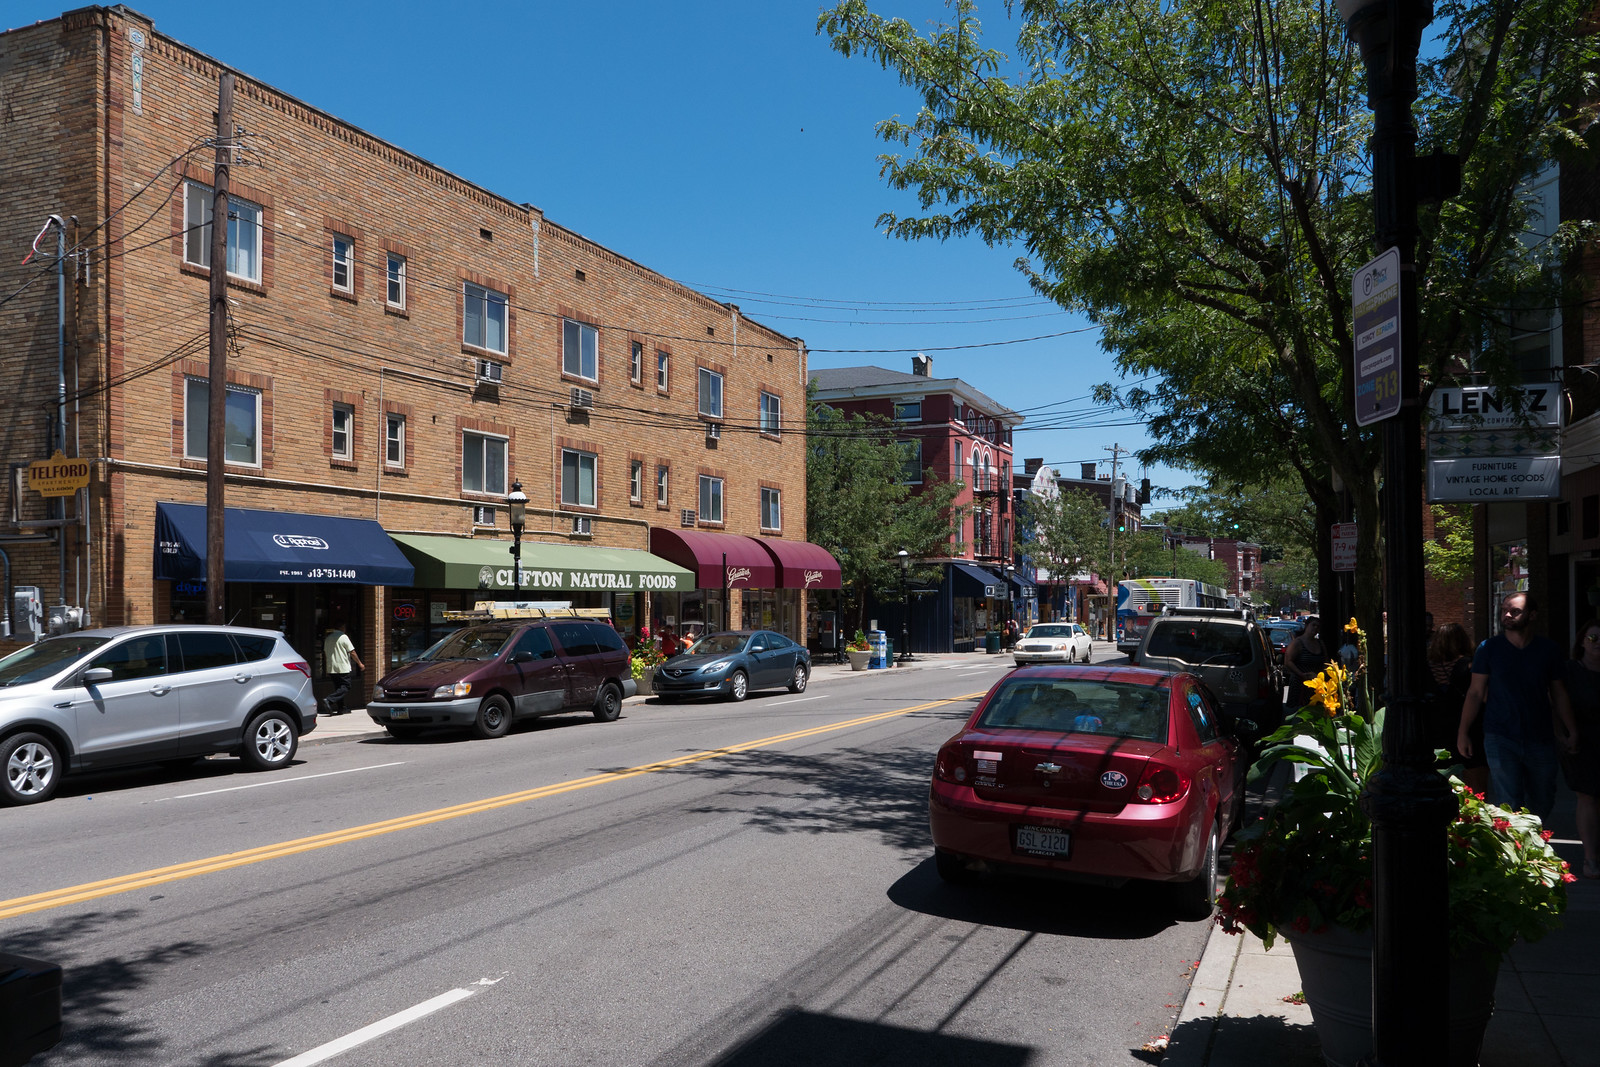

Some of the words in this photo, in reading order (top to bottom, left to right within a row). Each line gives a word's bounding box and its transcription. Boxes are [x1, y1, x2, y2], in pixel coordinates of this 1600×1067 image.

[1374, 285, 1398, 304] PHONE
[1362, 331, 1376, 344] CINCY
[1376, 321, 1394, 337] EZPARK
[1357, 379, 1375, 397] ZONE
[1375, 370, 1397, 401] 513
[1487, 417, 1519, 425] COMPAN
[30, 464, 88, 480] TELFORD
[1472, 463, 1517, 471] FURNITURE
[1446, 476, 1480, 484] VINTAGE
[1483, 475, 1507, 483] HOME
[1511, 474, 1544, 482] GOODS
[1469, 488, 1499, 496] LOCAL
[1502, 487, 1519, 495] ART
[1335, 543, 1346, 551] 7-9
[496, 570, 563, 587] CLFTON
[570, 572, 633, 588] NATURAL
[639, 574, 677, 589] FOODS
[394, 606, 416, 618] OPEN
[1153, 603, 1160, 611] 17
[1107, 772, 1112, 780] I
[1019, 831, 1037, 847] GSL
[1041, 834, 1066, 850] 2120
